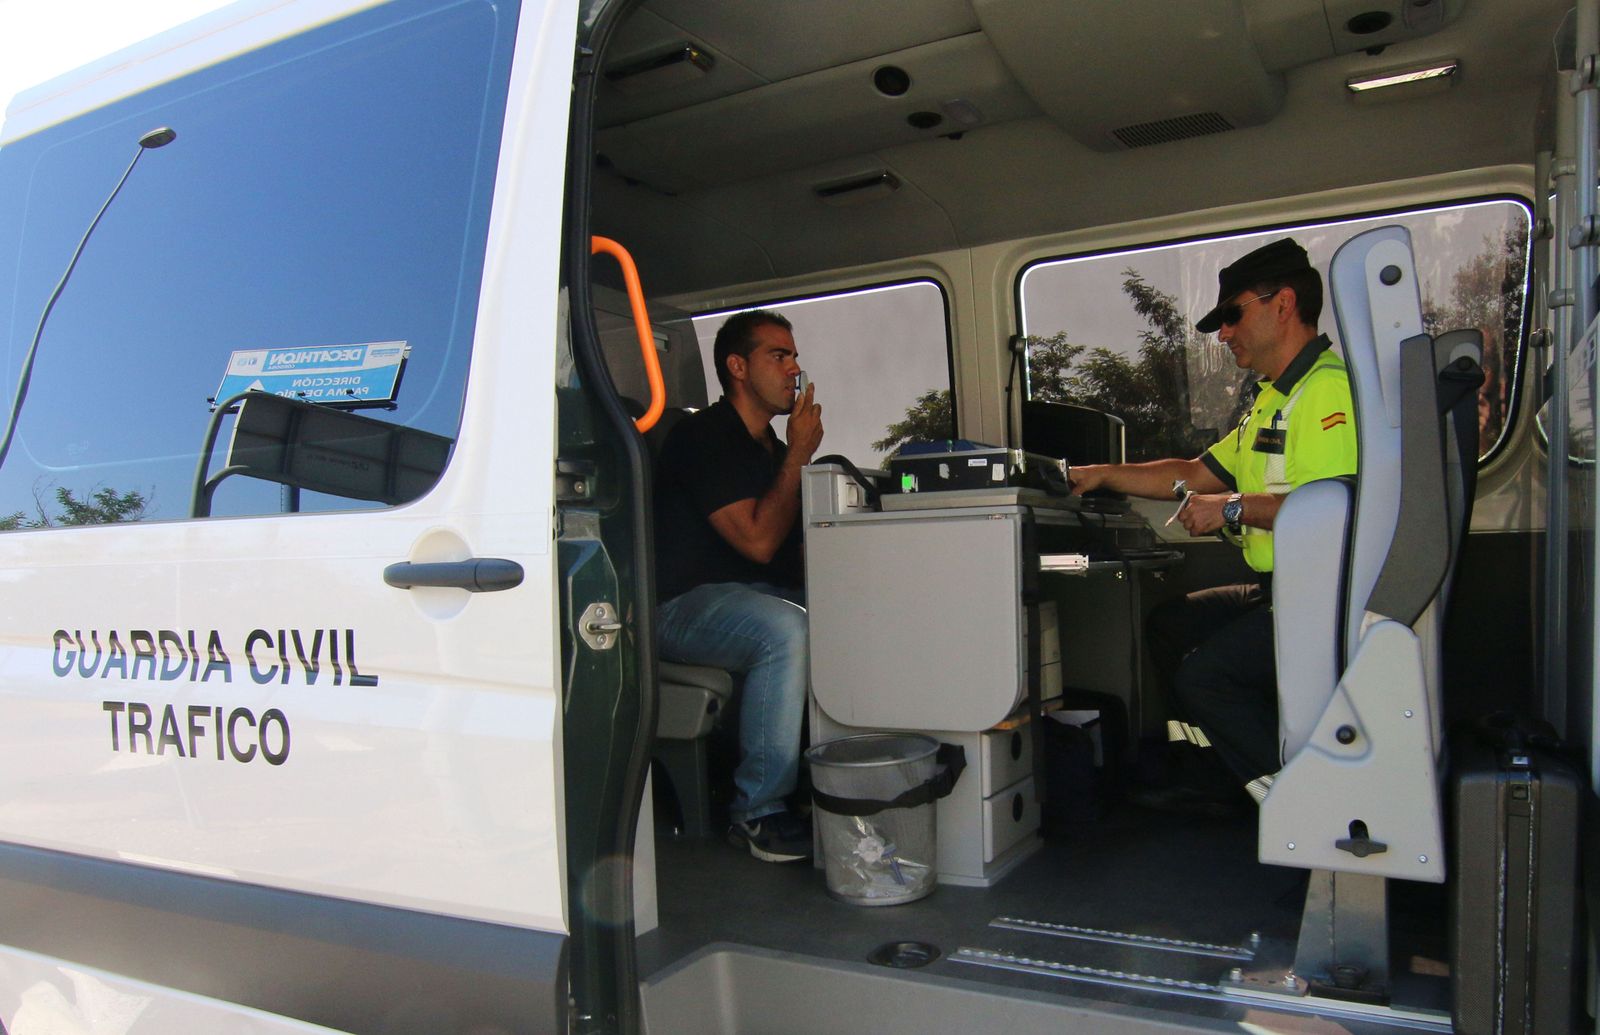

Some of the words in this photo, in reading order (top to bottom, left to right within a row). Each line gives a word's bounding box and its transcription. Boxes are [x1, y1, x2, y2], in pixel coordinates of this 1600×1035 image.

[52, 629, 233, 683] GUARDIA
[244, 629, 379, 687] CIVIL
[103, 701, 291, 766] TRAFICO
